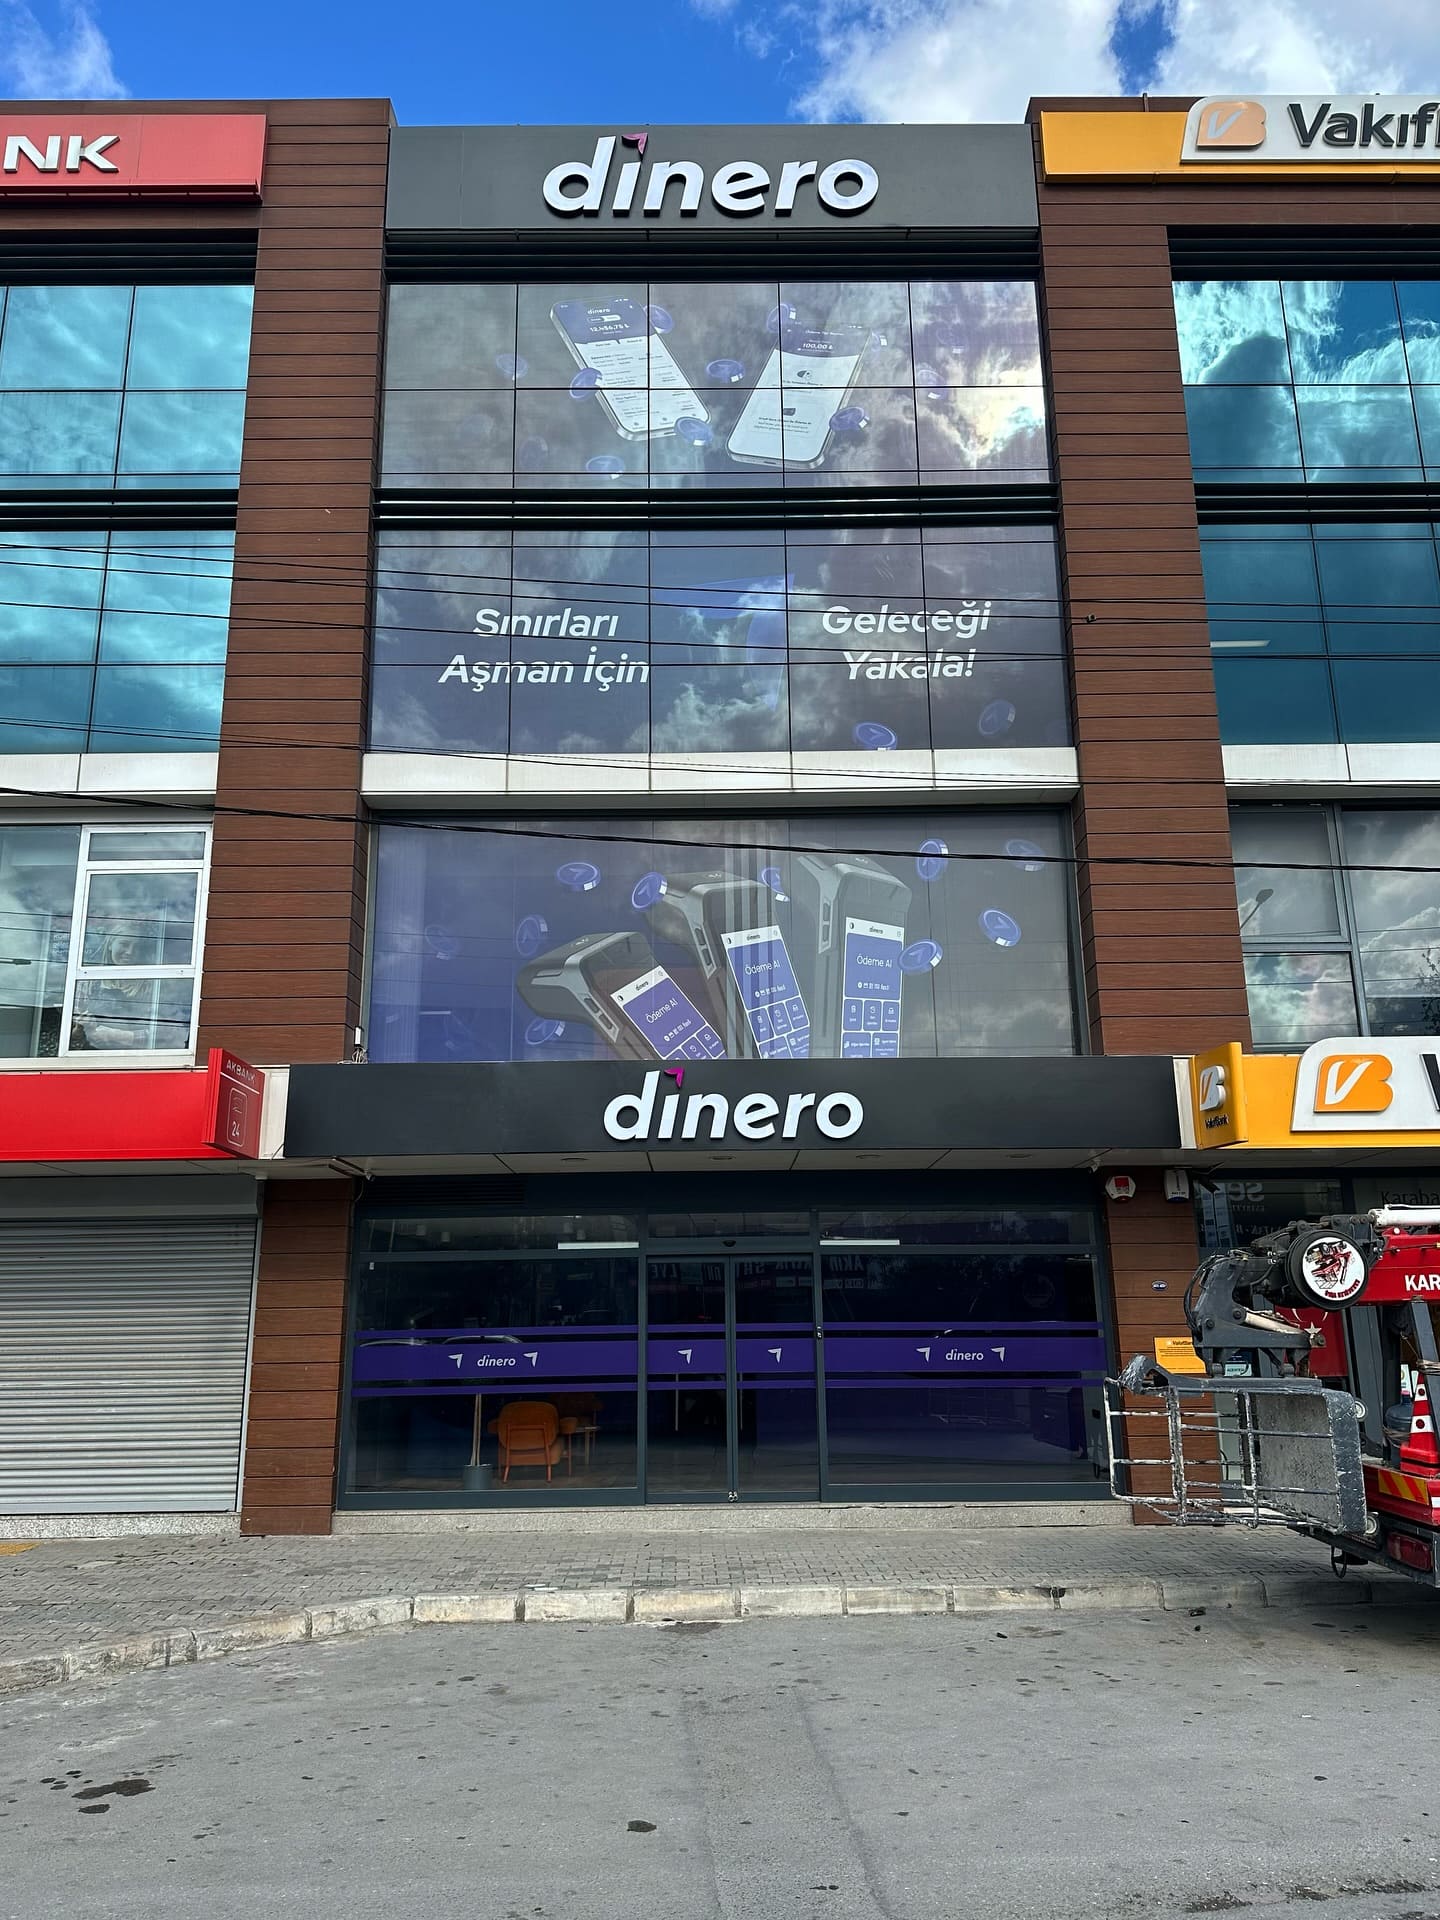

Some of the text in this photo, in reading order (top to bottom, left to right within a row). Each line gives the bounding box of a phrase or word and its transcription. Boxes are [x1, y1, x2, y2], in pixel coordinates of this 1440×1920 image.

[1287, 102, 1440, 147] Vakıf
[542, 132, 880, 217] dinero
[472, 607, 619, 637] Sınırları
[822, 600, 993, 639] Geleceği
[438, 645, 650, 692] Aşman İçin
[843, 648, 977, 680] Yakala!
[856, 953, 884, 967] Ödeme
[226, 1059, 256, 1085] AKBANK
[603, 1067, 865, 1142] dinero
[231, 1120, 241, 1137] 24
[476, 1353, 517, 1368] dinero
[945, 1347, 985, 1362] dinero
